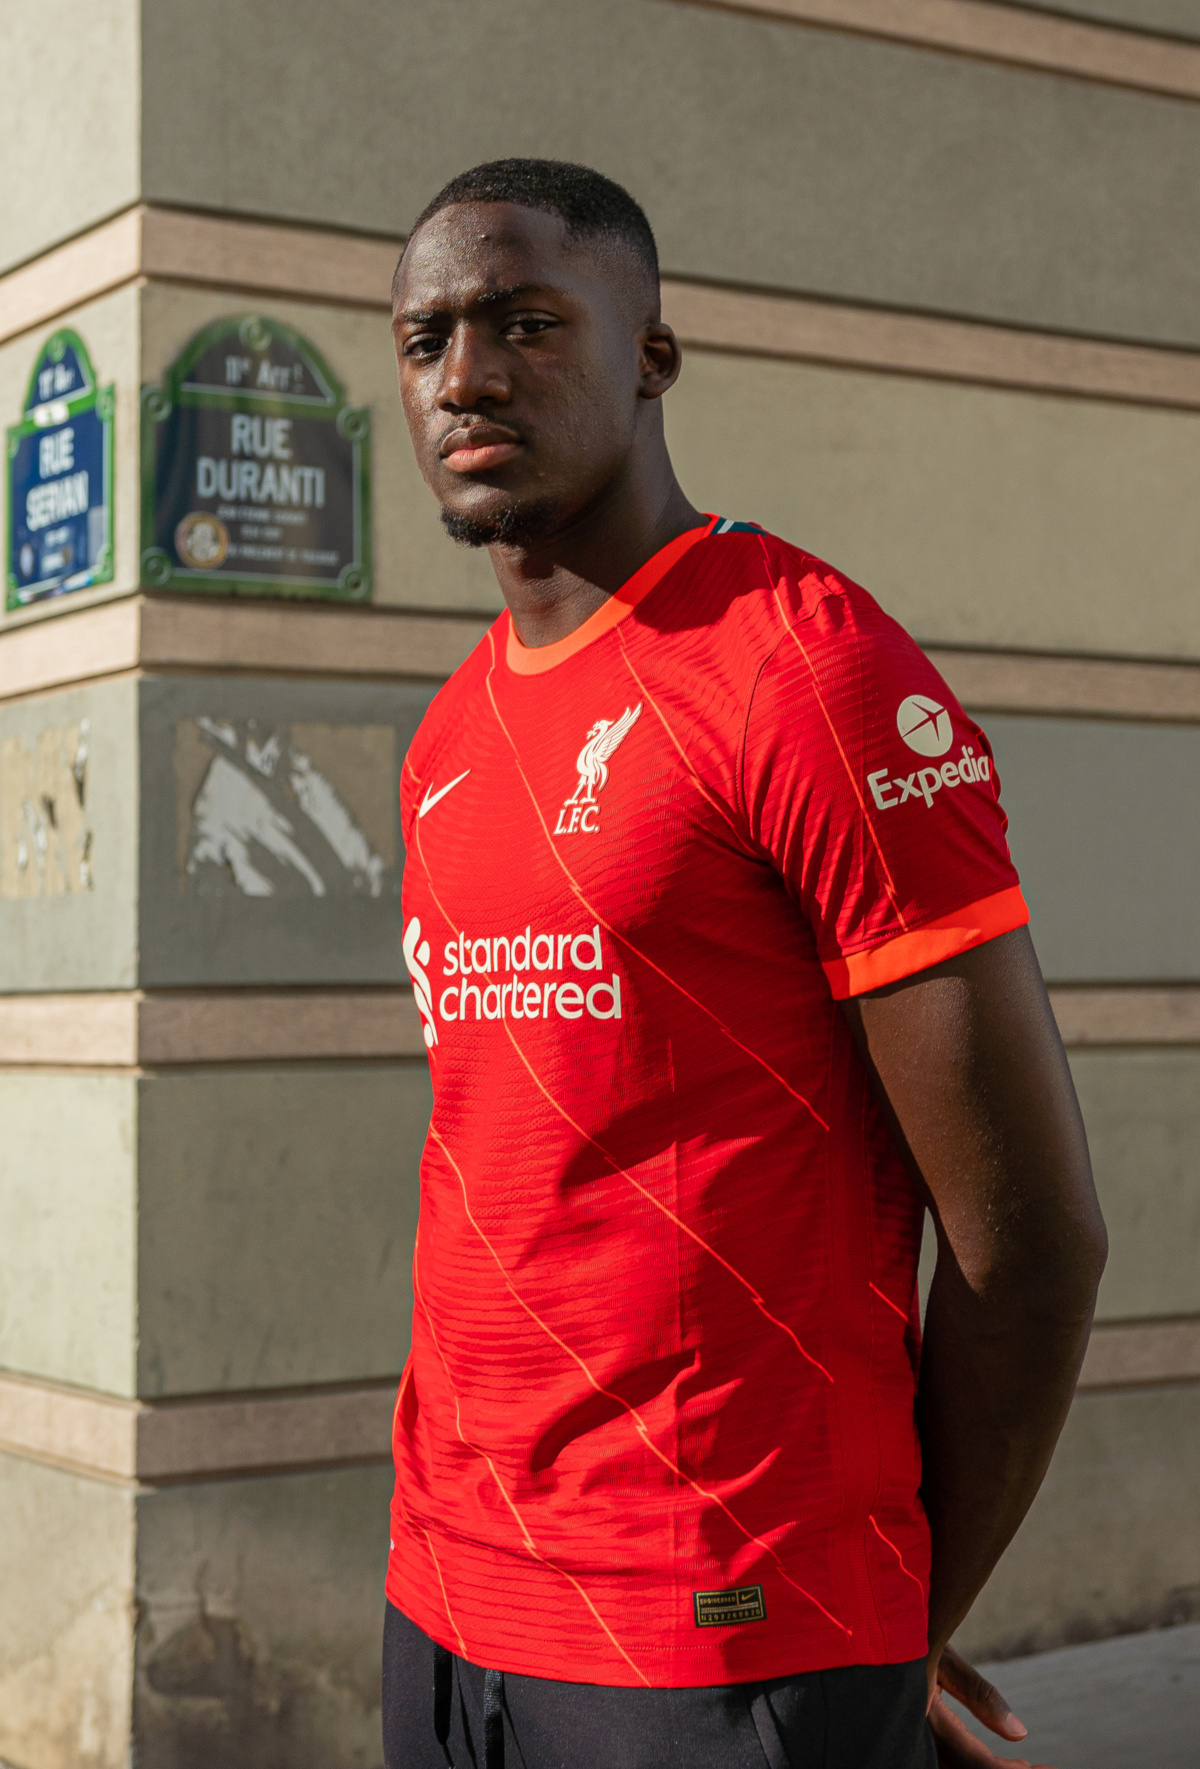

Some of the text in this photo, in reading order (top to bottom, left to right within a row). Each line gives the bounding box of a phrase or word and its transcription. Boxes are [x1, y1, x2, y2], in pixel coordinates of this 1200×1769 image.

[39, 427, 74, 479] RUE
[231, 413, 293, 459] RUE
[196, 456, 325, 509] DURANTI
[867, 745, 990, 810] Expedia
[443, 924, 603, 976] standard
[439, 973, 622, 1021] chartered
